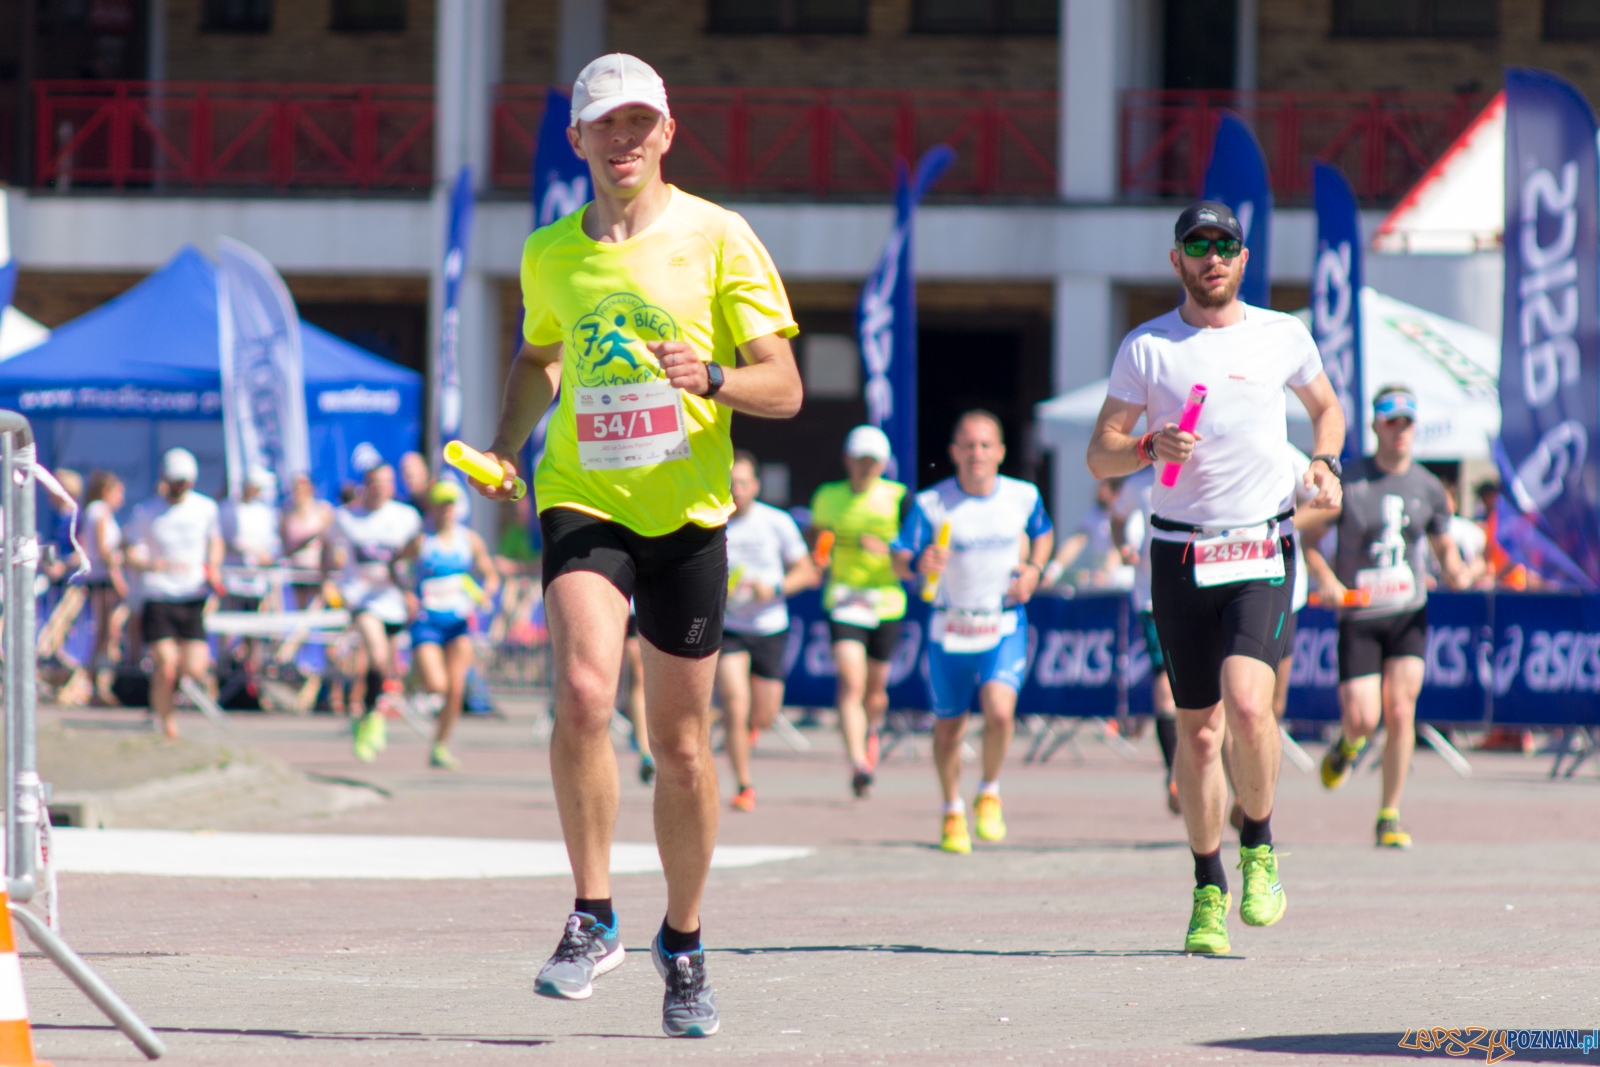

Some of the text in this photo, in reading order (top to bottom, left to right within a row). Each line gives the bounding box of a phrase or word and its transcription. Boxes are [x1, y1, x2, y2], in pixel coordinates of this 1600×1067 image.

[600, 296, 640, 315] POZNAŃSKI
[580, 321, 600, 357] 7
[593, 410, 653, 438] 54/1
[1203, 541, 1264, 562] 245/1
[685, 617, 703, 644] GORE
